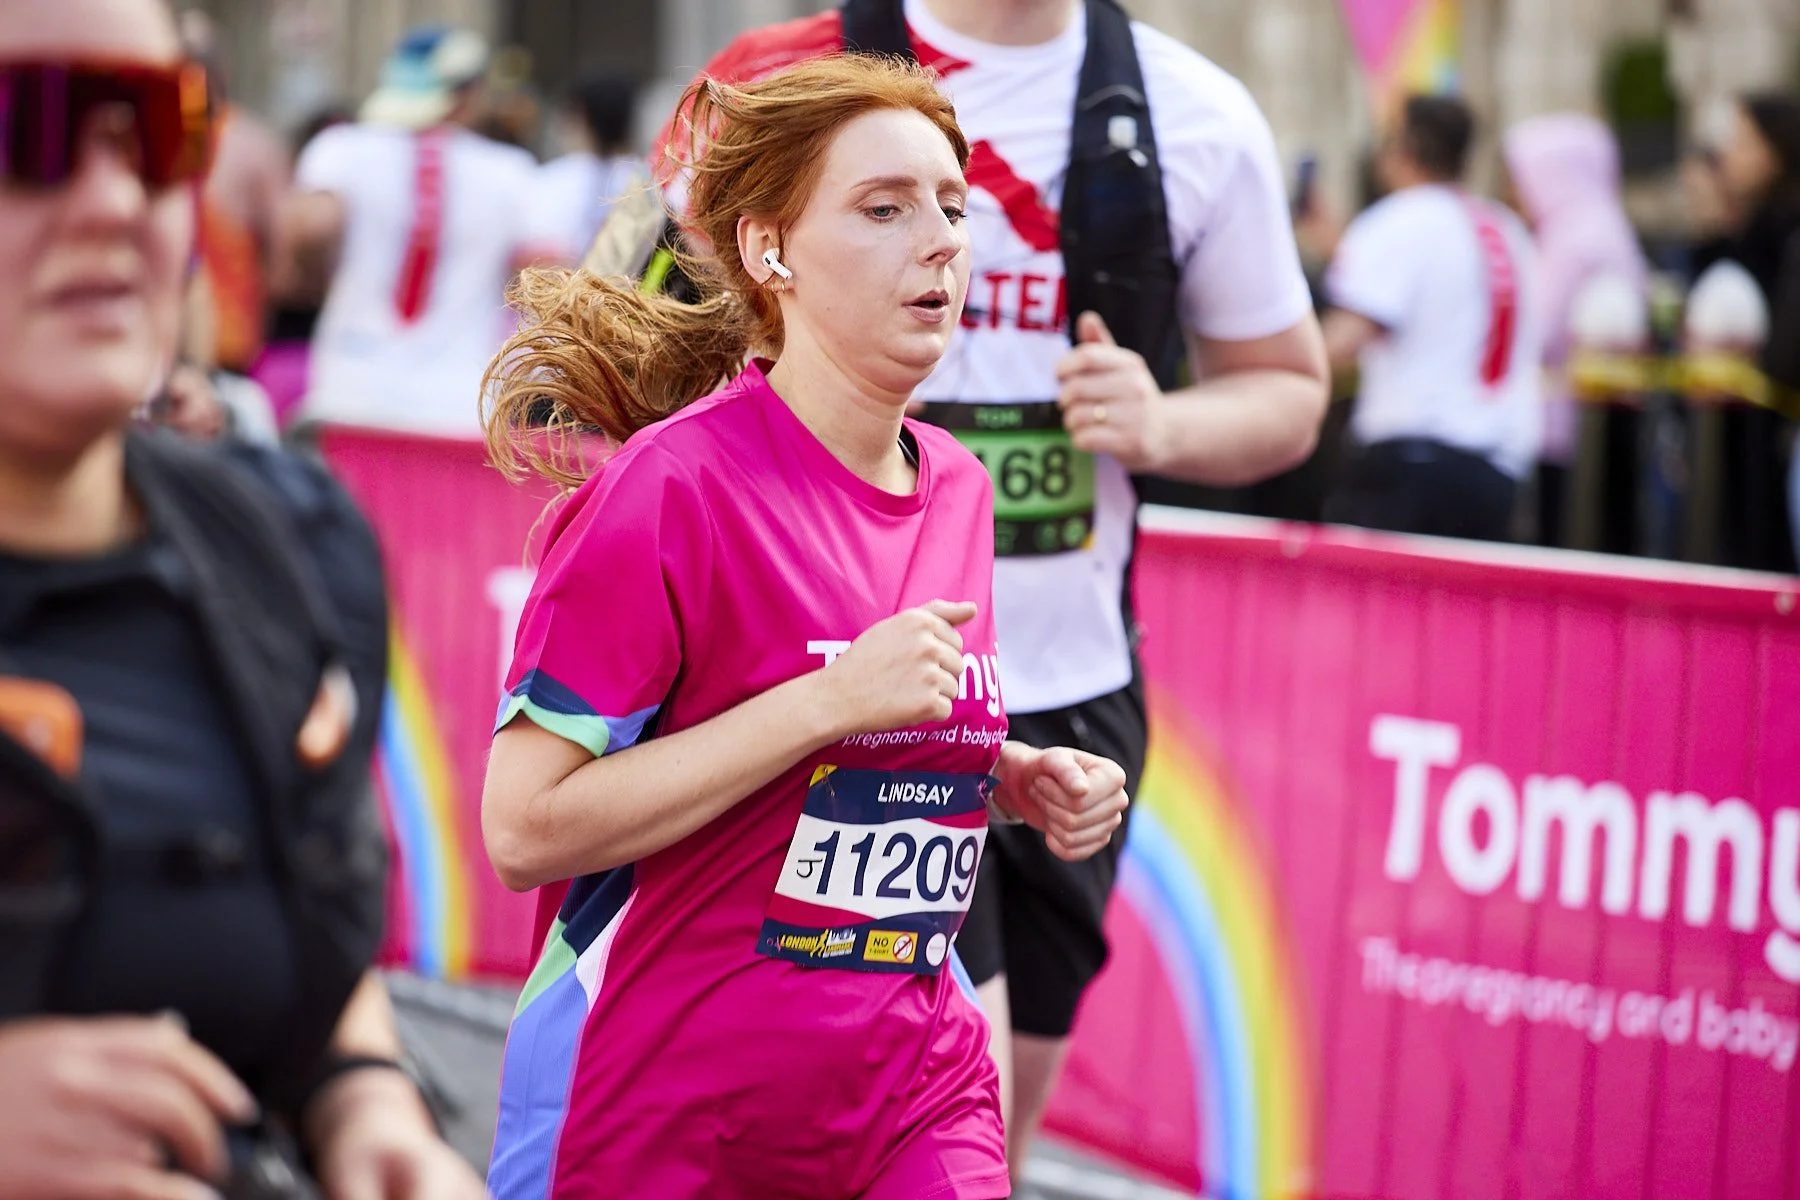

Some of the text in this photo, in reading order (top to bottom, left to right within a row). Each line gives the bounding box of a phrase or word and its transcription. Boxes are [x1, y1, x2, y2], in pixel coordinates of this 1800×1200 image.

[974, 445, 1072, 502] 68
[961, 724, 992, 749] baby
[877, 782, 954, 806] LINDSAY
[813, 830, 979, 903] 11209
[780, 934, 819, 952] LONDON
[873, 937, 889, 947] NO
[1697, 990, 1799, 1073] baby
